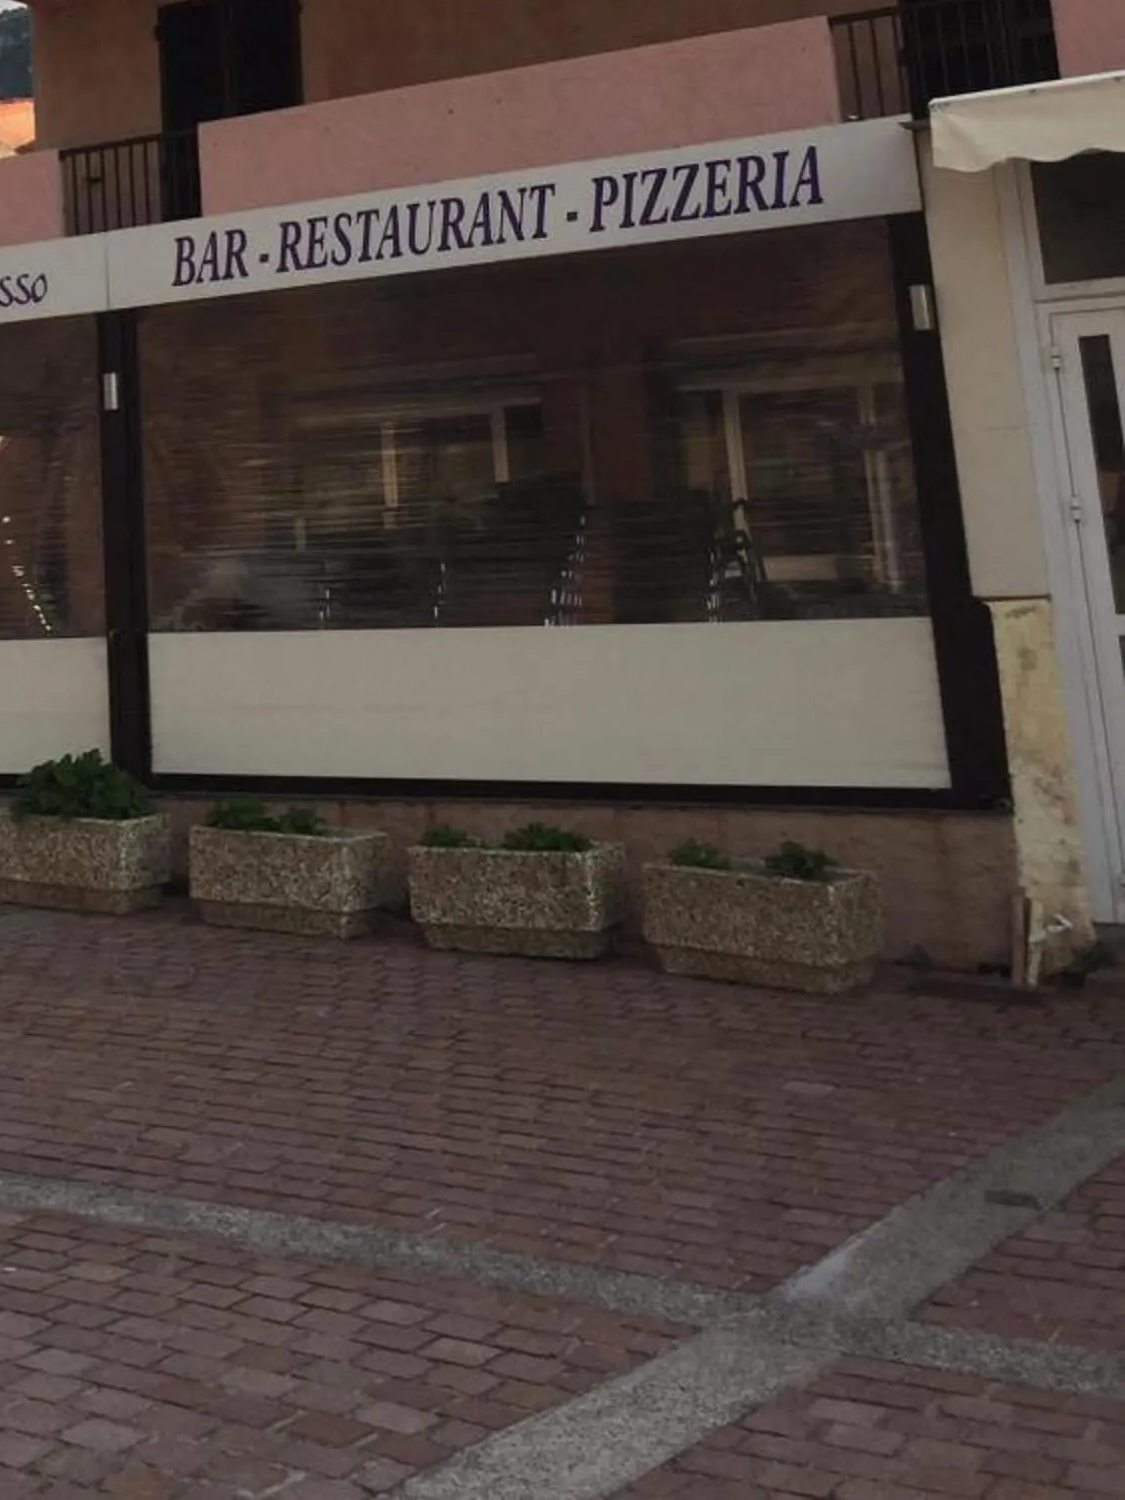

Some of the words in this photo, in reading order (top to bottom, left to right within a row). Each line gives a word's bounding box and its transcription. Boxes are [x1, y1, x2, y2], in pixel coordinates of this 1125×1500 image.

[172, 227, 249, 288] BAR
[276, 183, 556, 274] RESTAURANT
[589, 145, 824, 234] PIZZERIA
